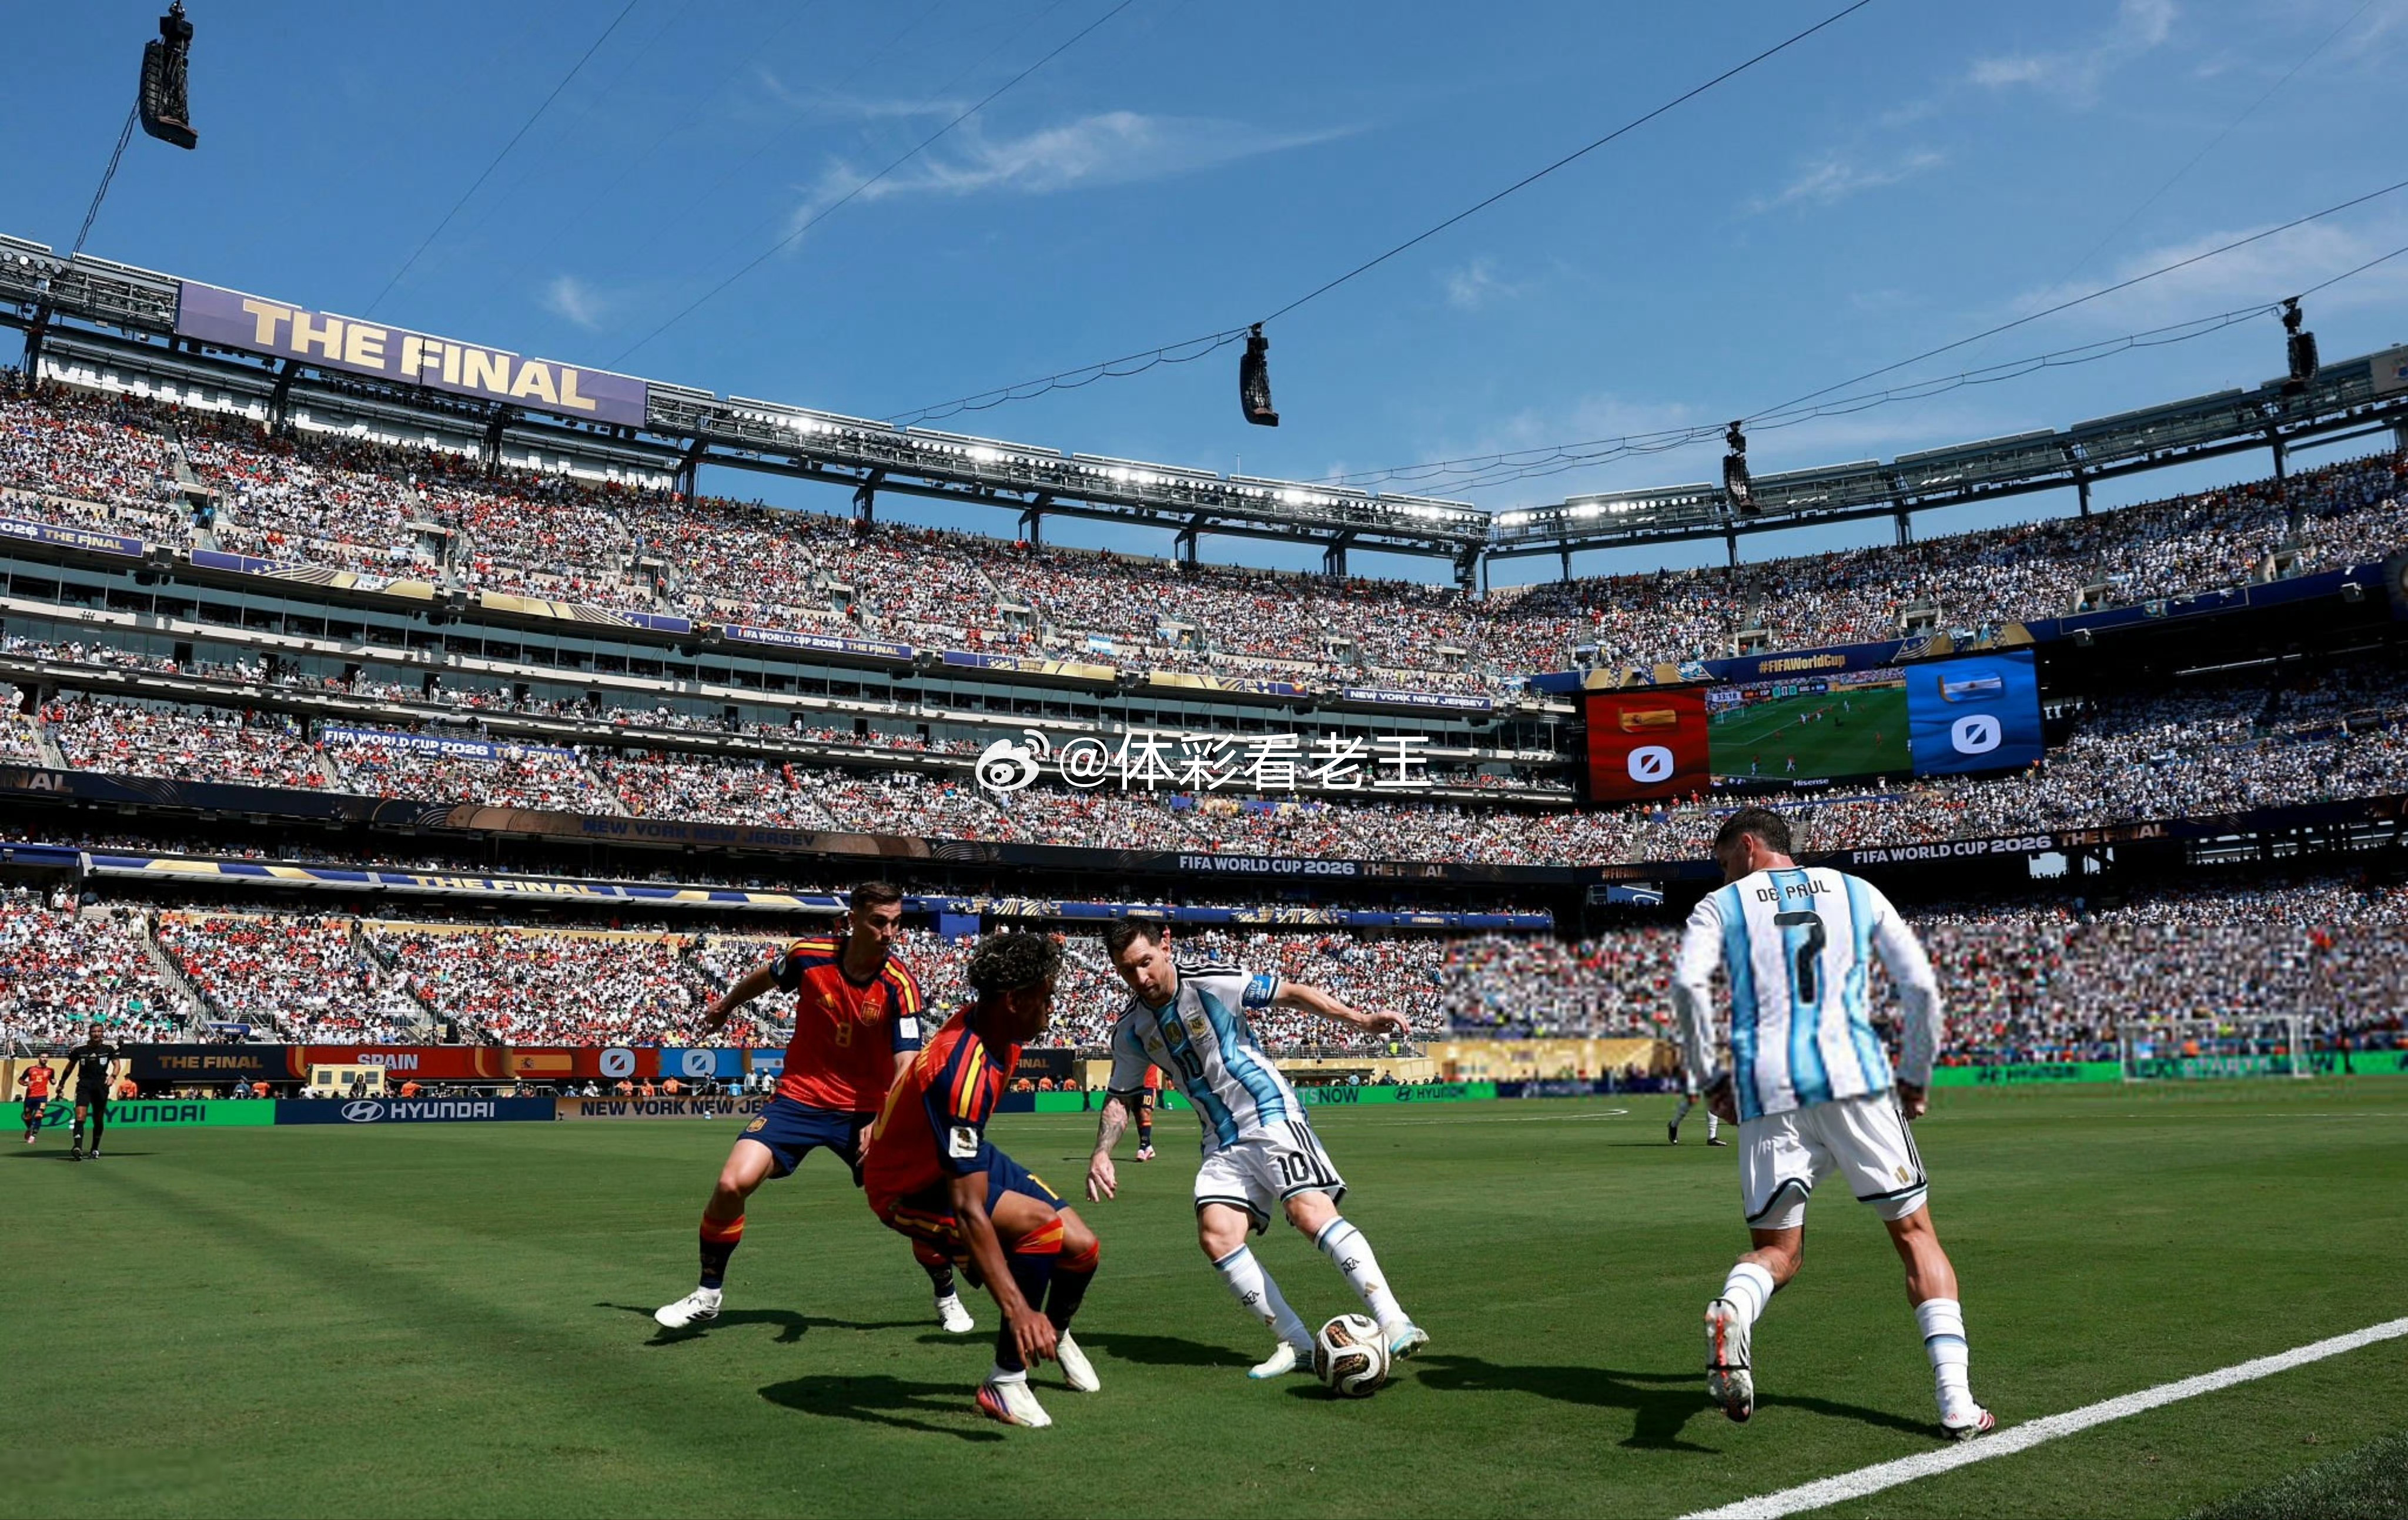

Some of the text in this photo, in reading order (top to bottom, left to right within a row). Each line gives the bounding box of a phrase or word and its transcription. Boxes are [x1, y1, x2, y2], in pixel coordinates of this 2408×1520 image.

[243, 298, 596, 411] THE FINAL
[44, 529, 76, 543] THE
[78, 535, 125, 550] FINAL
[760, 631, 792, 643] WORLD
[793, 634, 811, 645] CUP
[812, 638, 844, 649] 2026
[847, 641, 867, 652] THE
[868, 644, 900, 655] FINAL
[1758, 654, 1846, 674] #FIFAWorldCup
[1350, 690, 1485, 708] NEW YORK NEW JERSEY
[325, 730, 354, 742] FIFA
[357, 733, 410, 747] WORLD
[412, 738, 440, 749] CUP
[441, 741, 489, 755] 2026
[1951, 715, 2001, 754] 0
[1628, 746, 1674, 782] 0
[1793, 779, 1829, 787] Hisense
[582, 819, 816, 846] NEW YORK NEW JERSEY
[1853, 849, 1888, 864] FIFA
[1890, 844, 1951, 862] WORLD
[1954, 841, 1988, 855] CUP
[1990, 835, 2052, 852] 2026
[2058, 830, 2101, 847] THE
[1179, 855, 1212, 870] FIFA
[1214, 857, 1269, 873] WORLD
[1272, 859, 1302, 873] CUP
[1303, 861, 1356, 875] 2026
[1362, 863, 1395, 876] THE
[407, 875, 602, 896] THE FINAL
[1756, 880, 1832, 902] DE PAUL
[1774, 910, 1827, 1004] 7
[835, 1021, 852, 1048] 8
[158, 1056, 263, 1069] THE FINAL
[357, 1053, 419, 1070] SPAIN
[600, 1048, 636, 1077] 0
[682, 1048, 716, 1077] 0
[391, 1102, 494, 1119] HYUNDAI
[581, 1101, 627, 1116] NEW
[633, 1100, 686, 1116] YORK
[691, 1100, 734, 1114] NEW
[1143, 1094, 1152, 1106] 10
[1276, 1151, 1309, 1186] 10
